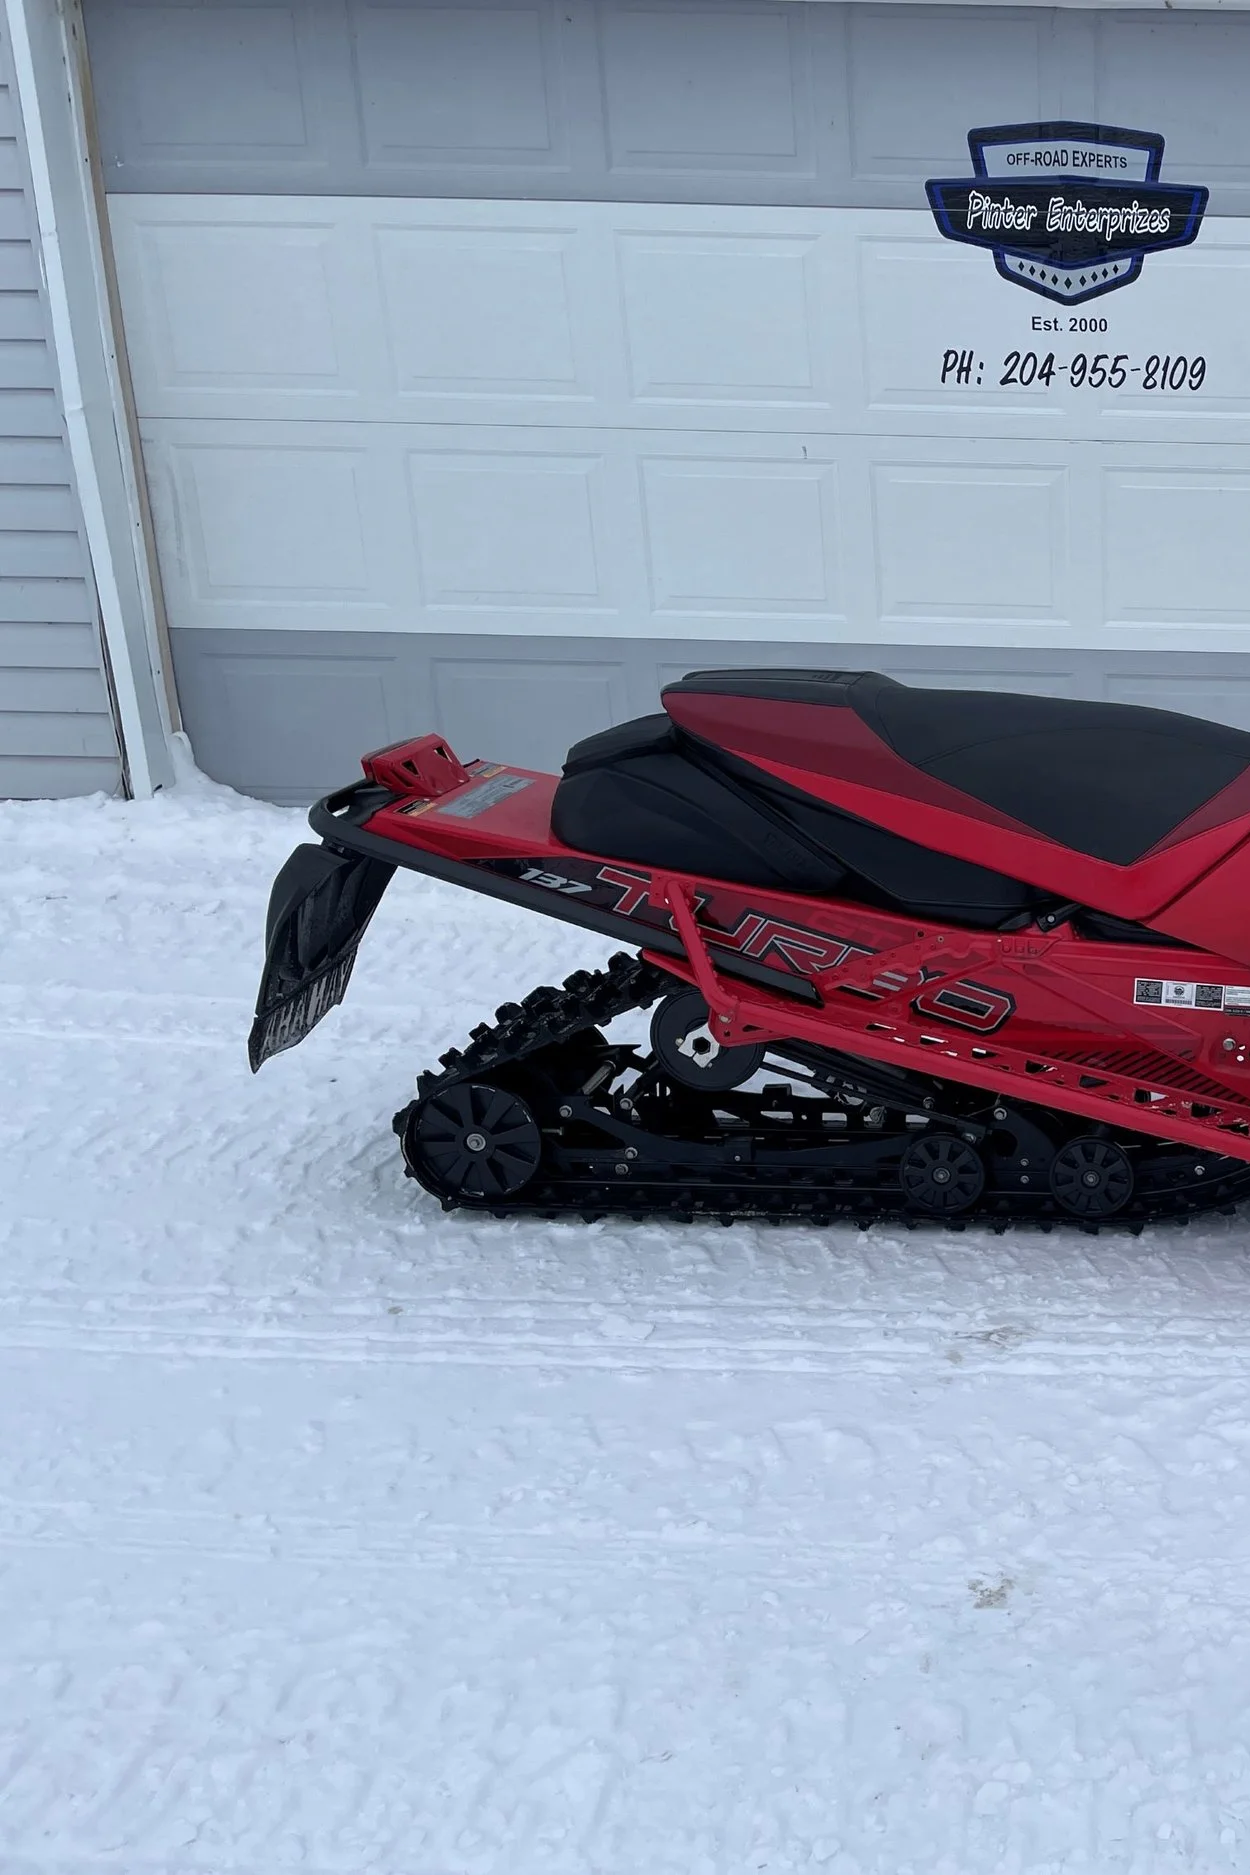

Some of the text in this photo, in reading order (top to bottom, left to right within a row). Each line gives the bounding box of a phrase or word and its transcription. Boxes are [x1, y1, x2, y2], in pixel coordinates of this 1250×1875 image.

[1006, 149, 1128, 169] OFF-ROAD EXPERTS
[966, 190, 1171, 241] Pinter Enterprizes
[1031, 316, 1108, 333] Est. 2000
[940, 349, 1207, 391] PH: 204-955-8109
[517, 867, 593, 894] 137
